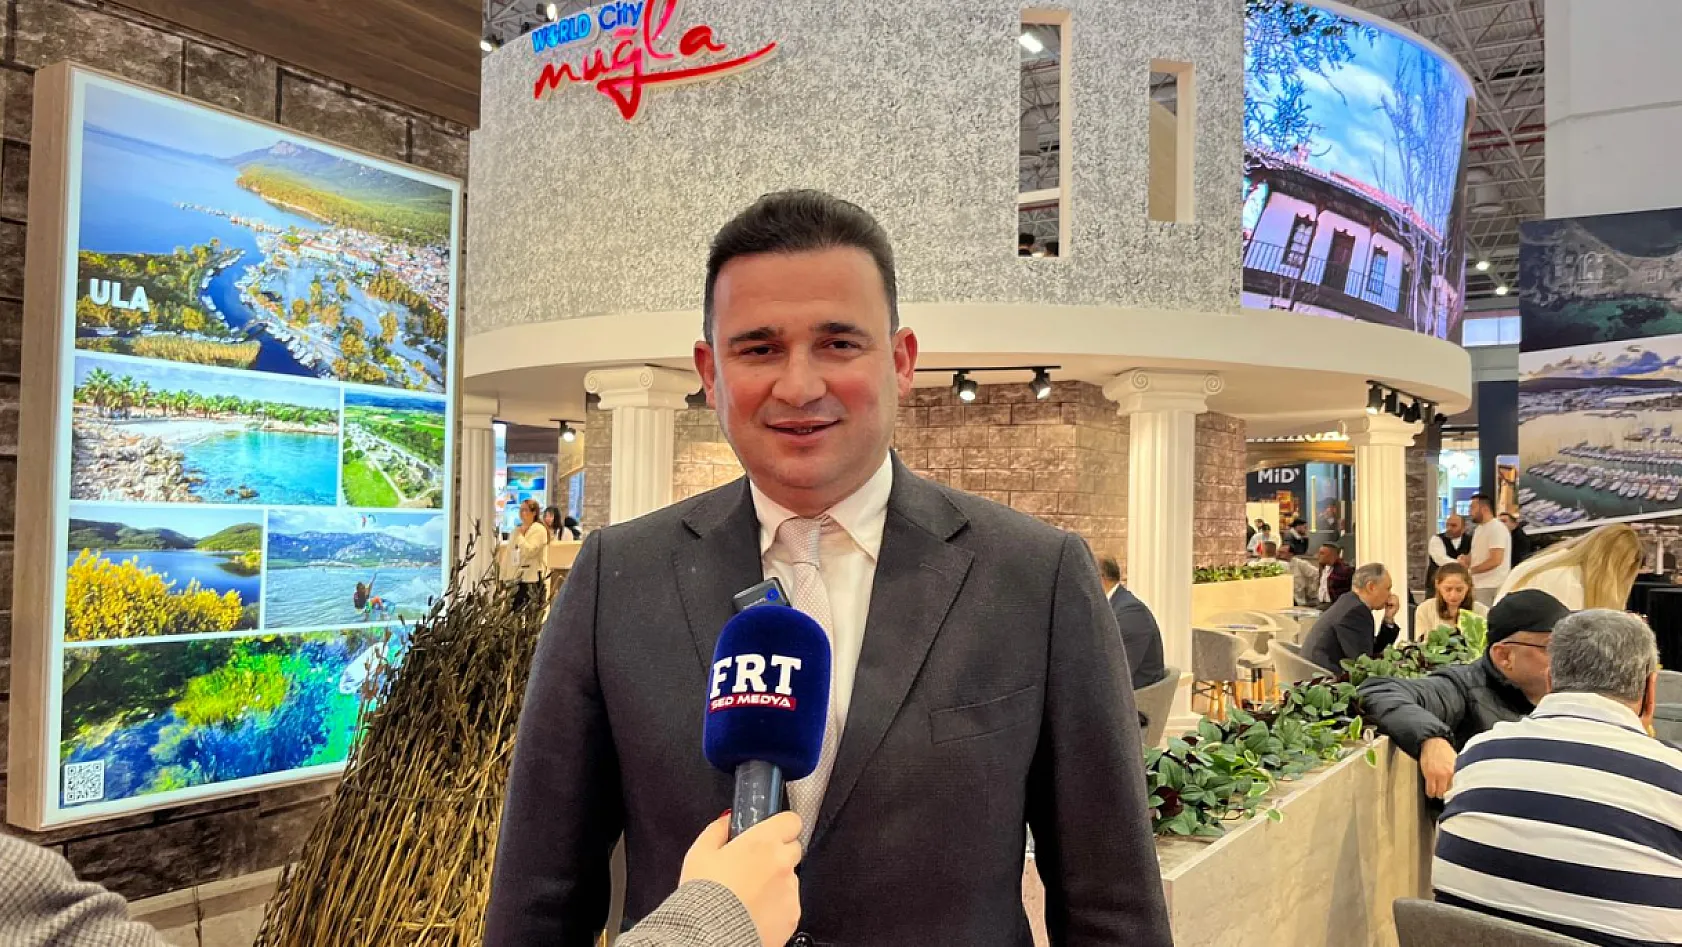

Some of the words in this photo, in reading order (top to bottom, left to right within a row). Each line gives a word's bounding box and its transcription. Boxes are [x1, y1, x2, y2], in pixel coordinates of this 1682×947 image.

[89, 278, 151, 313] ULA
[709, 653, 801, 700] FRT
[737, 693, 791, 708] MEDYA
